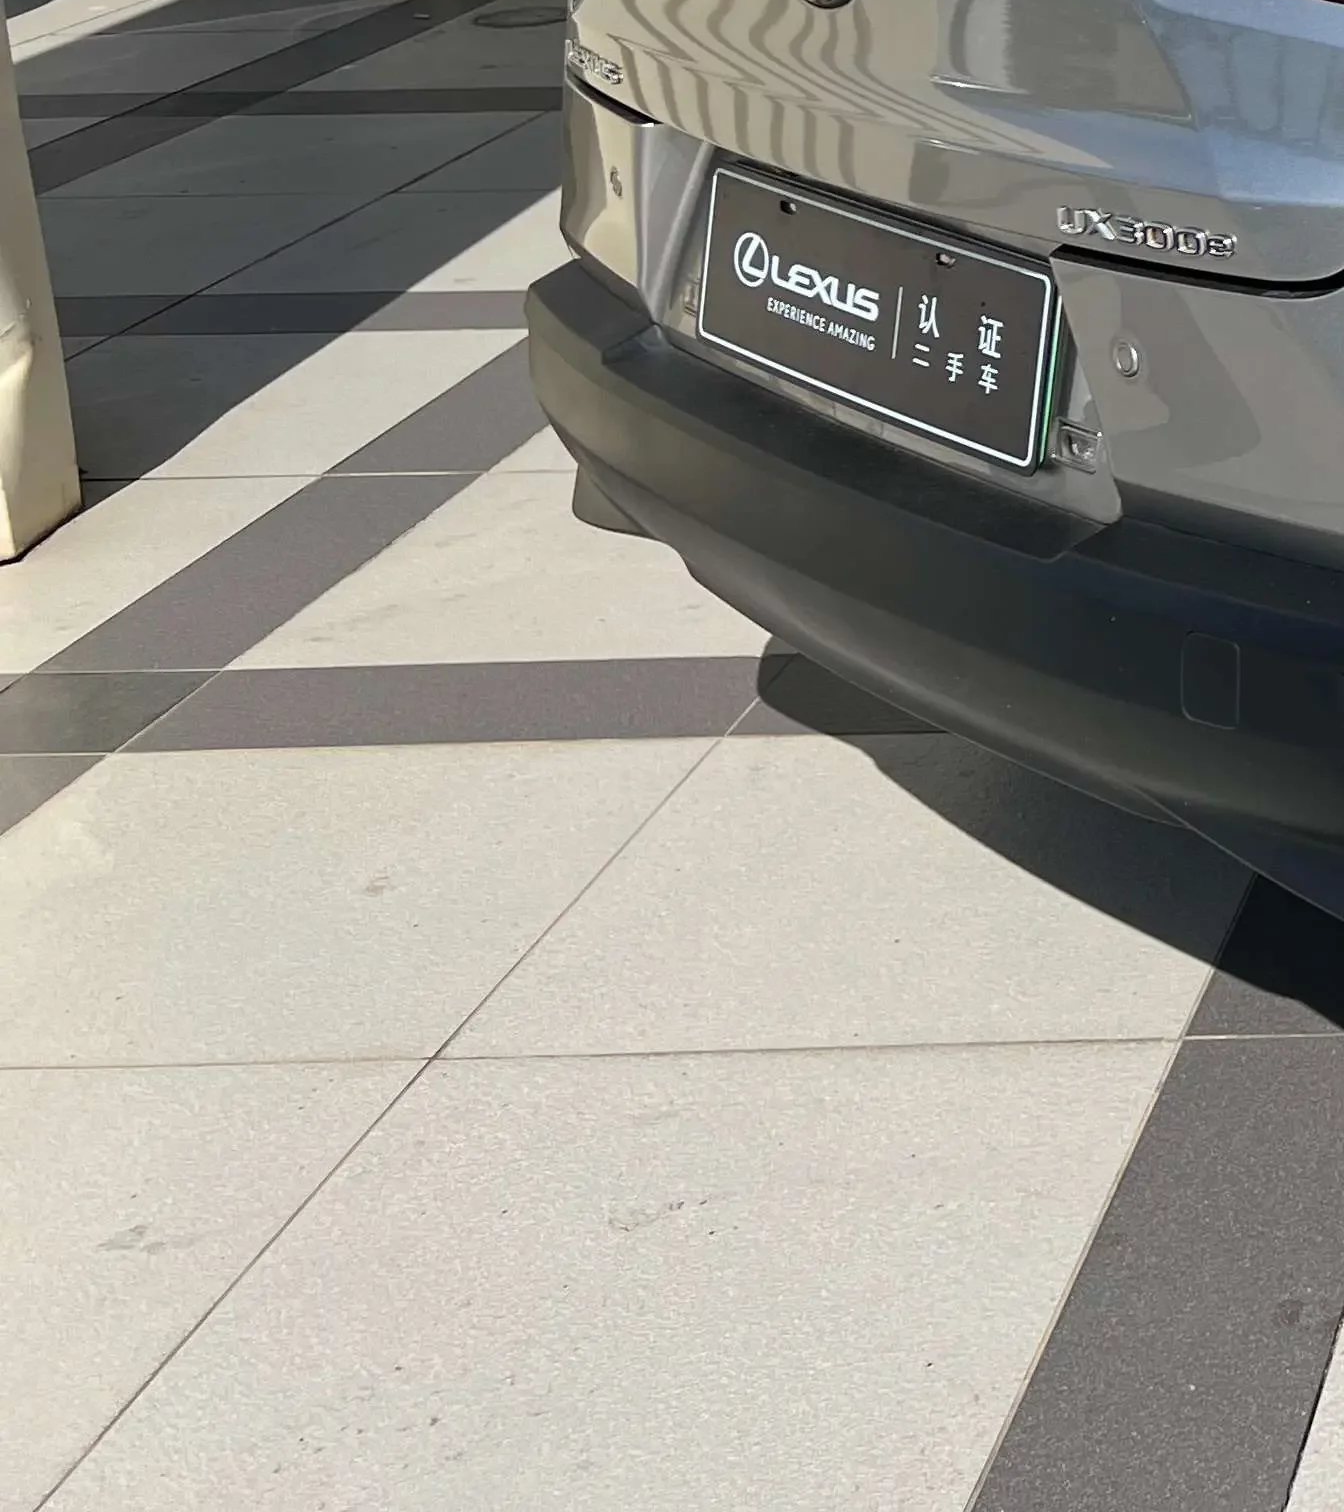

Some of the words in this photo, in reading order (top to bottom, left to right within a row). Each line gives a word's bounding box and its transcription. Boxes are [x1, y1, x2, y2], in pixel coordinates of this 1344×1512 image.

[1056, 205, 1238, 259] UX300e
[770, 255, 880, 322] LEXUS
[767, 297, 826, 333] EXPERIENCE
[827, 321, 876, 351] AMAZING
[918, 294, 1004, 359] 认证
[912, 343, 999, 394] 二手车
